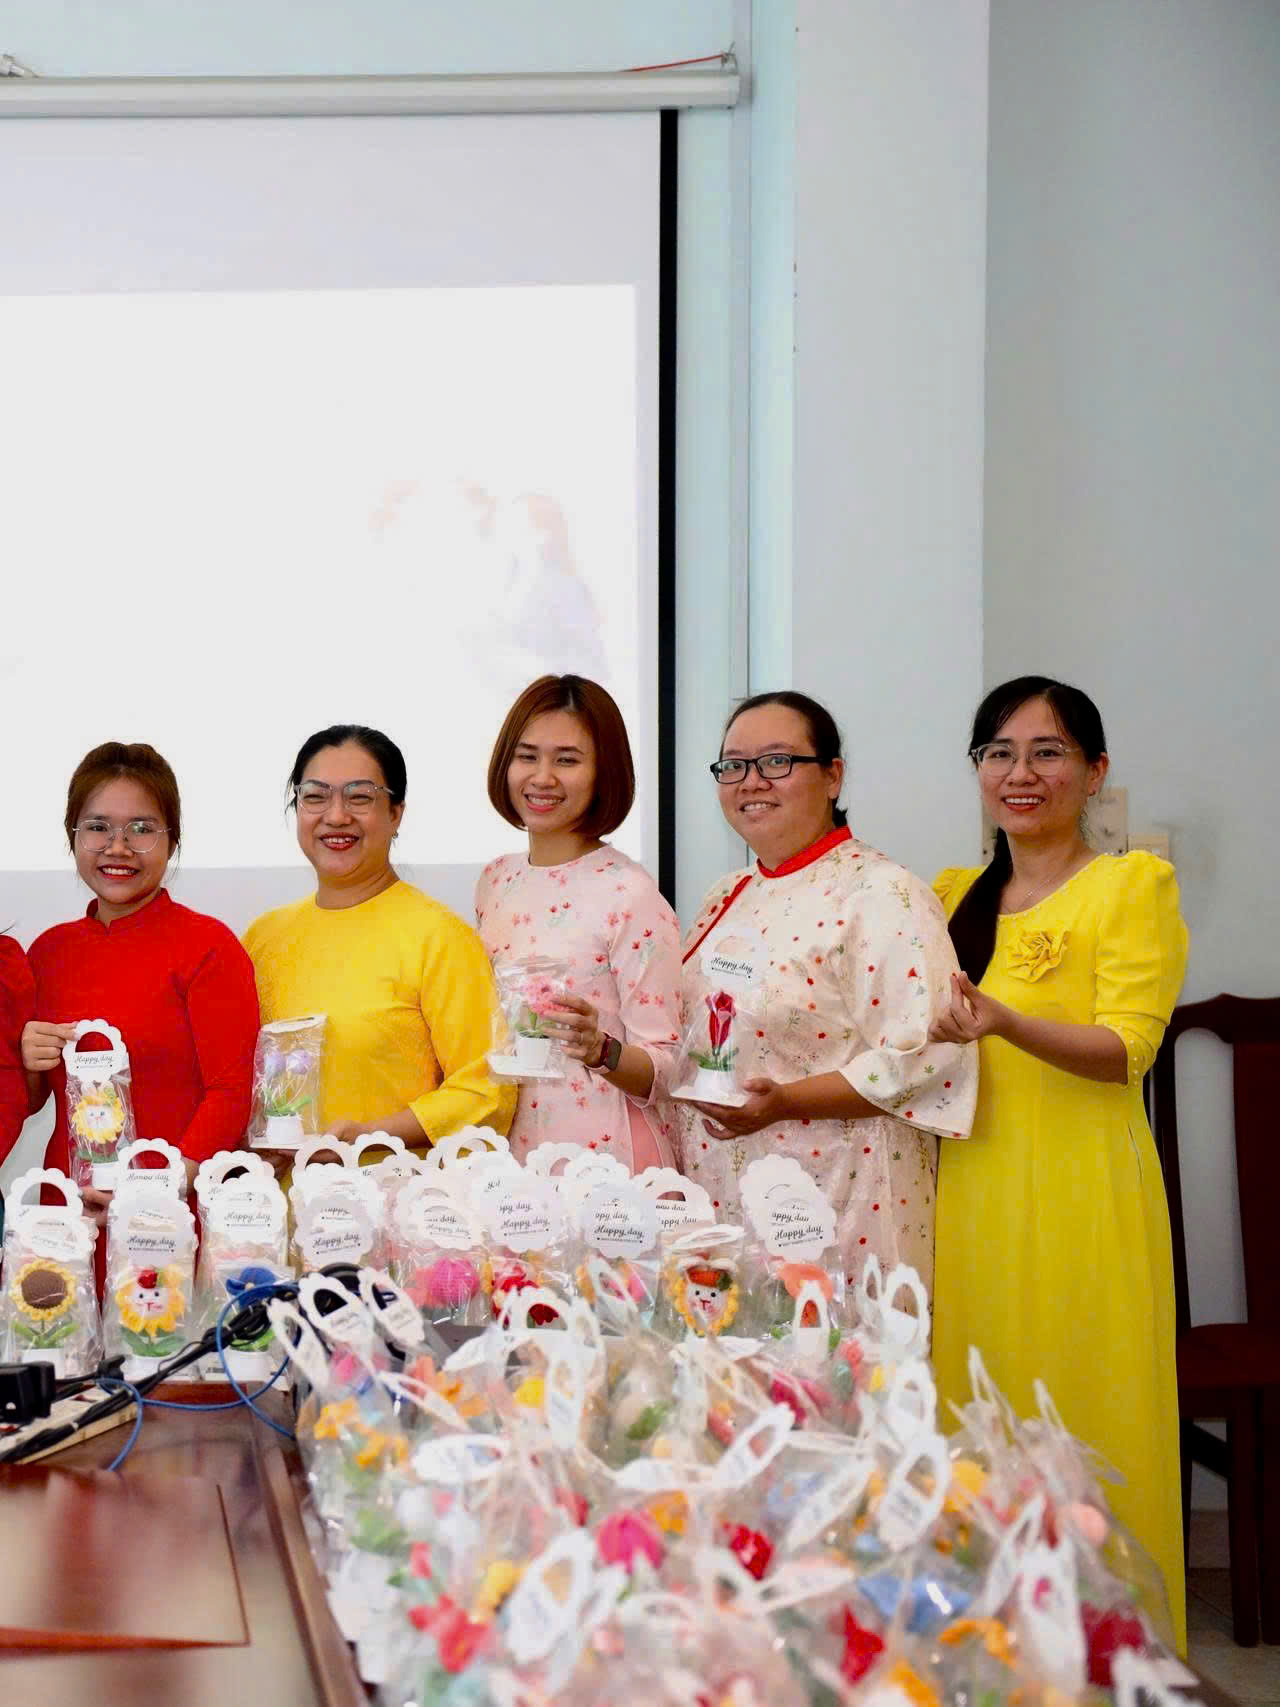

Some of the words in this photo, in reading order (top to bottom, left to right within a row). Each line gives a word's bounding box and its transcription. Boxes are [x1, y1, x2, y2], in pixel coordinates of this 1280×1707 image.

[710, 957, 737, 971] Happy
[738, 962, 753, 974] day
[223, 1211, 255, 1223] Happy
[256, 1211, 272, 1223] day
[501, 1219, 532, 1231] Happy
[532, 1215, 551, 1227] day
[771, 1212, 794, 1223] appy
[594, 1224, 627, 1238] Happy
[627, 1227, 645, 1240] day
[774, 1229, 807, 1241] Happy
[806, 1223, 824, 1236] day
[127, 1234, 159, 1247] Happy
[159, 1236, 177, 1249] day
[312, 1237, 344, 1249] Happy
[344, 1232, 361, 1244] day
